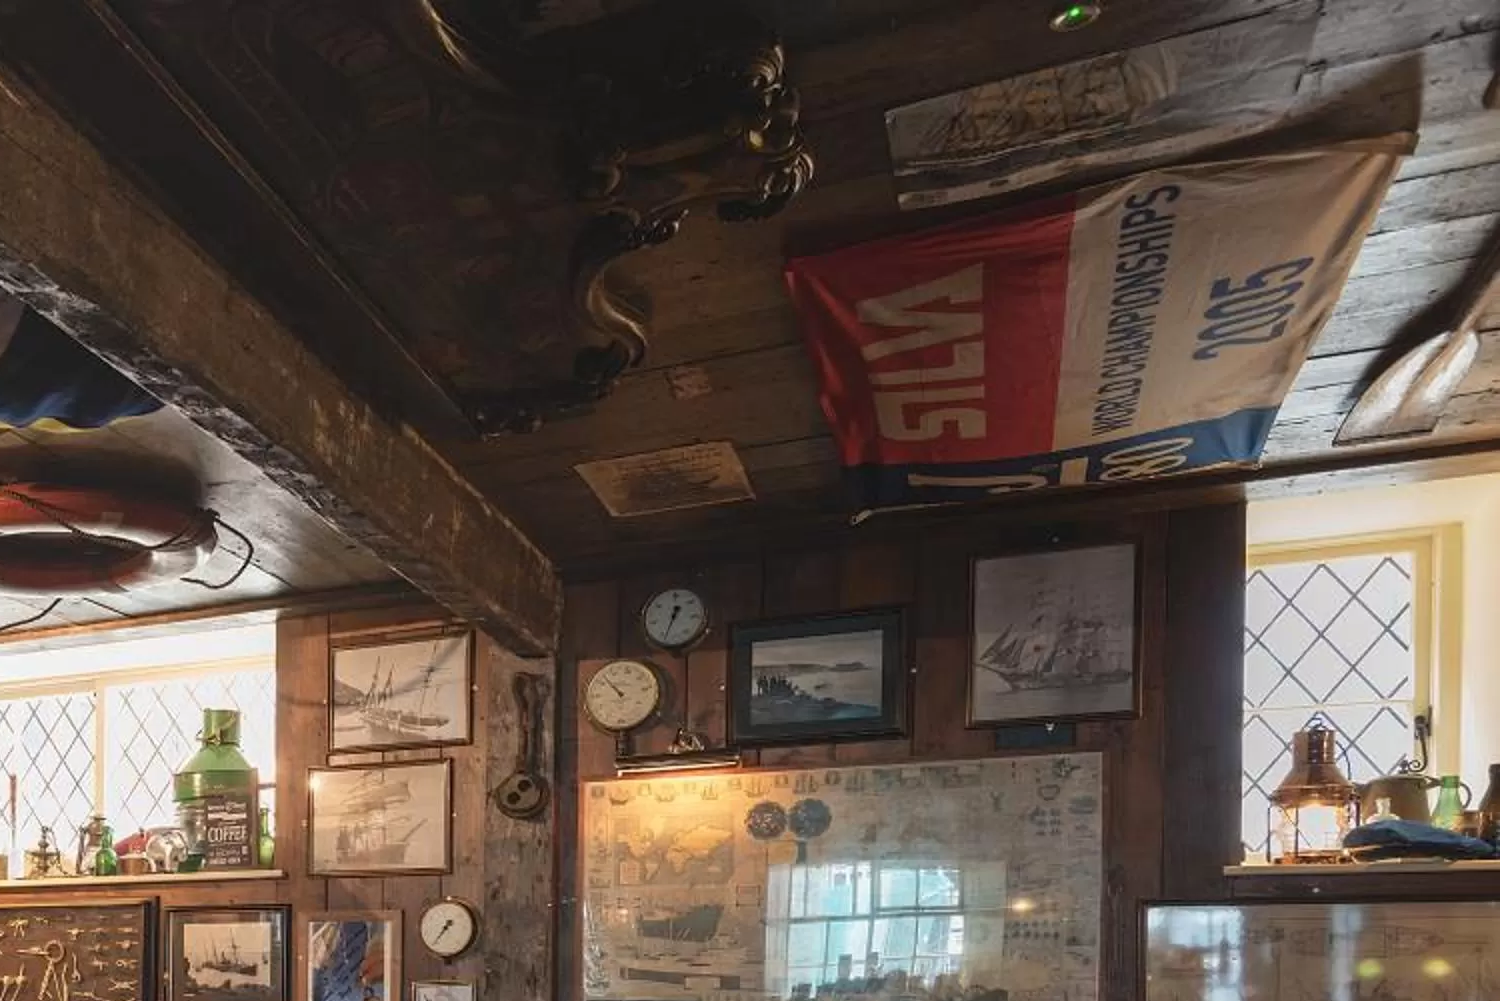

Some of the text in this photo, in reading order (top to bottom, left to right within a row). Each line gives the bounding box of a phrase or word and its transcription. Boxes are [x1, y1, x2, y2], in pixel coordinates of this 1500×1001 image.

[855, 263, 987, 441] SILVA
[1091, 184, 1182, 437] WORLD CHAMPIONSHIPS
[1191, 256, 1315, 361] 2005
